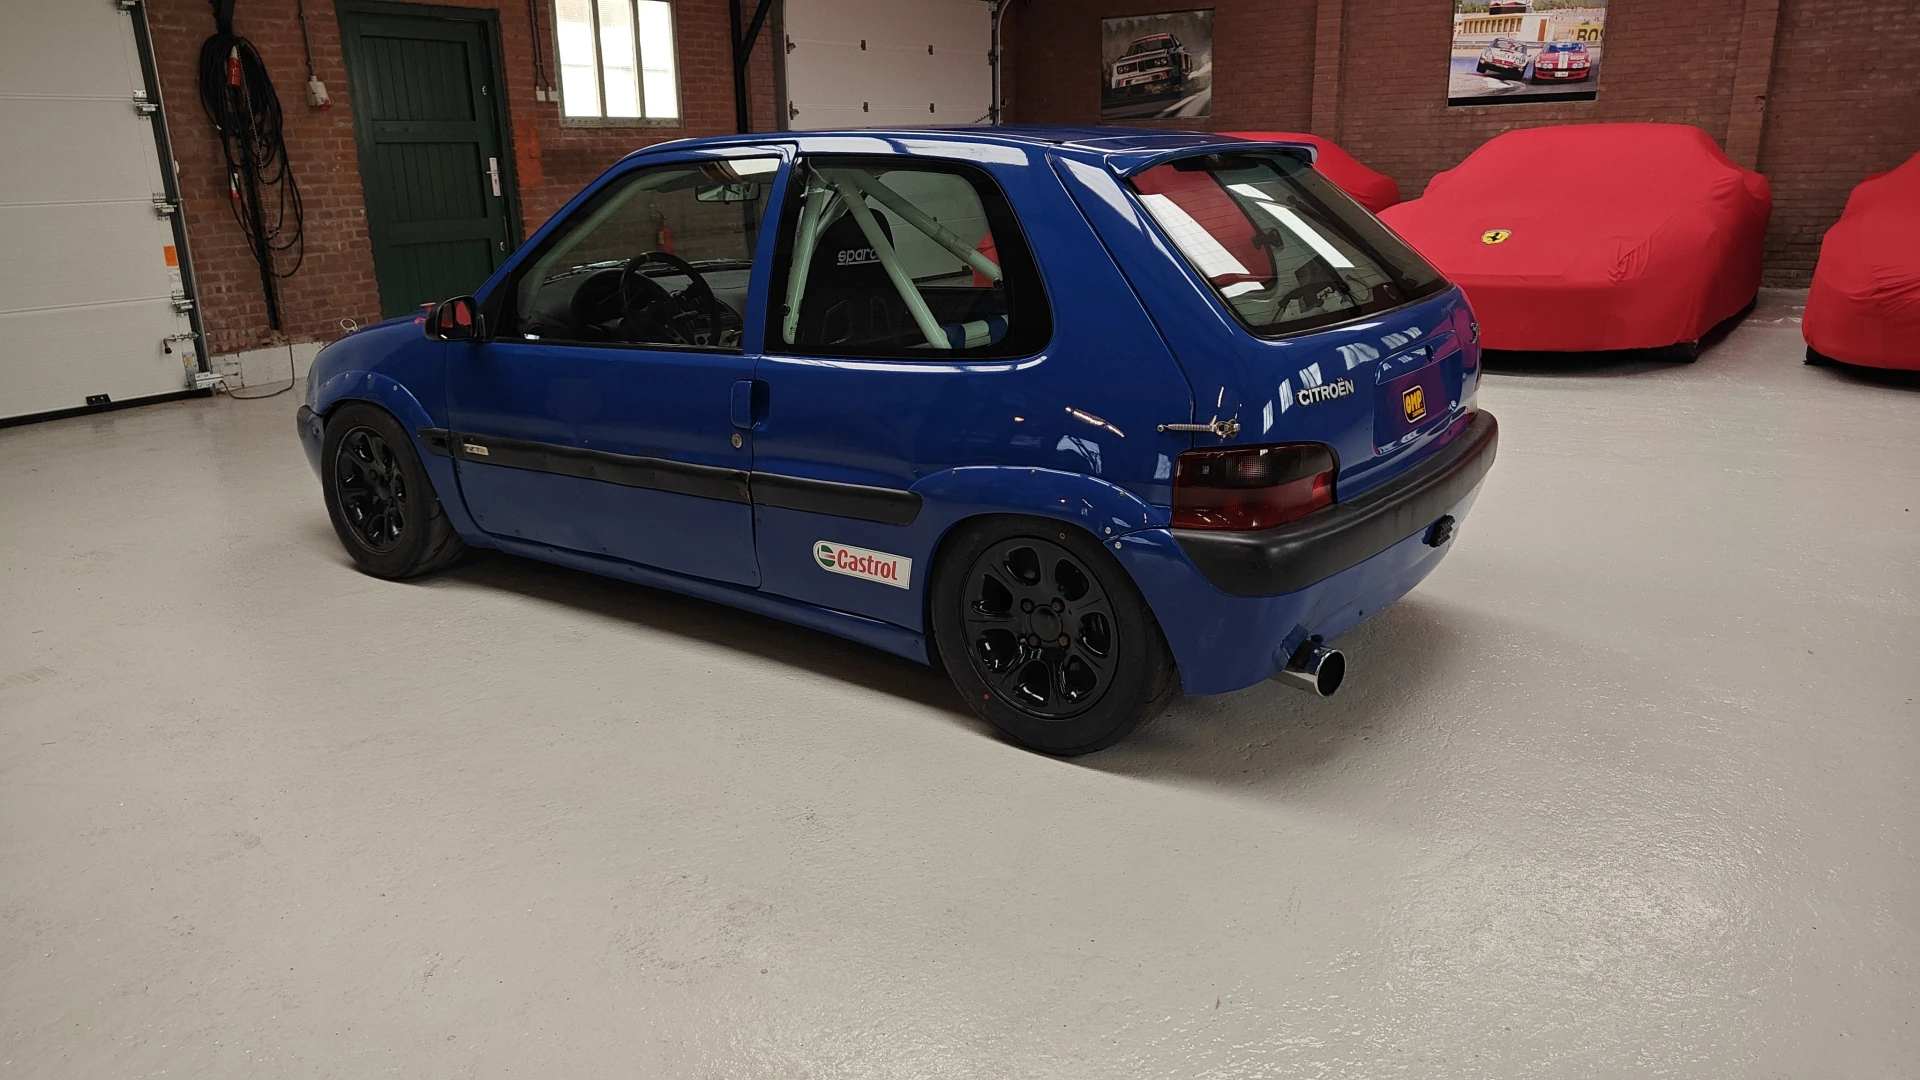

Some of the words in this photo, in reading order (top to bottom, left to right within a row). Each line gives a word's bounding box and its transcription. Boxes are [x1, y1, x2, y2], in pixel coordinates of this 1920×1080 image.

[837, 248, 880, 266] sparc
[1298, 378, 1355, 405] CITROËN
[1405, 390, 1422, 414] OMP
[837, 549, 898, 581] Castrol
